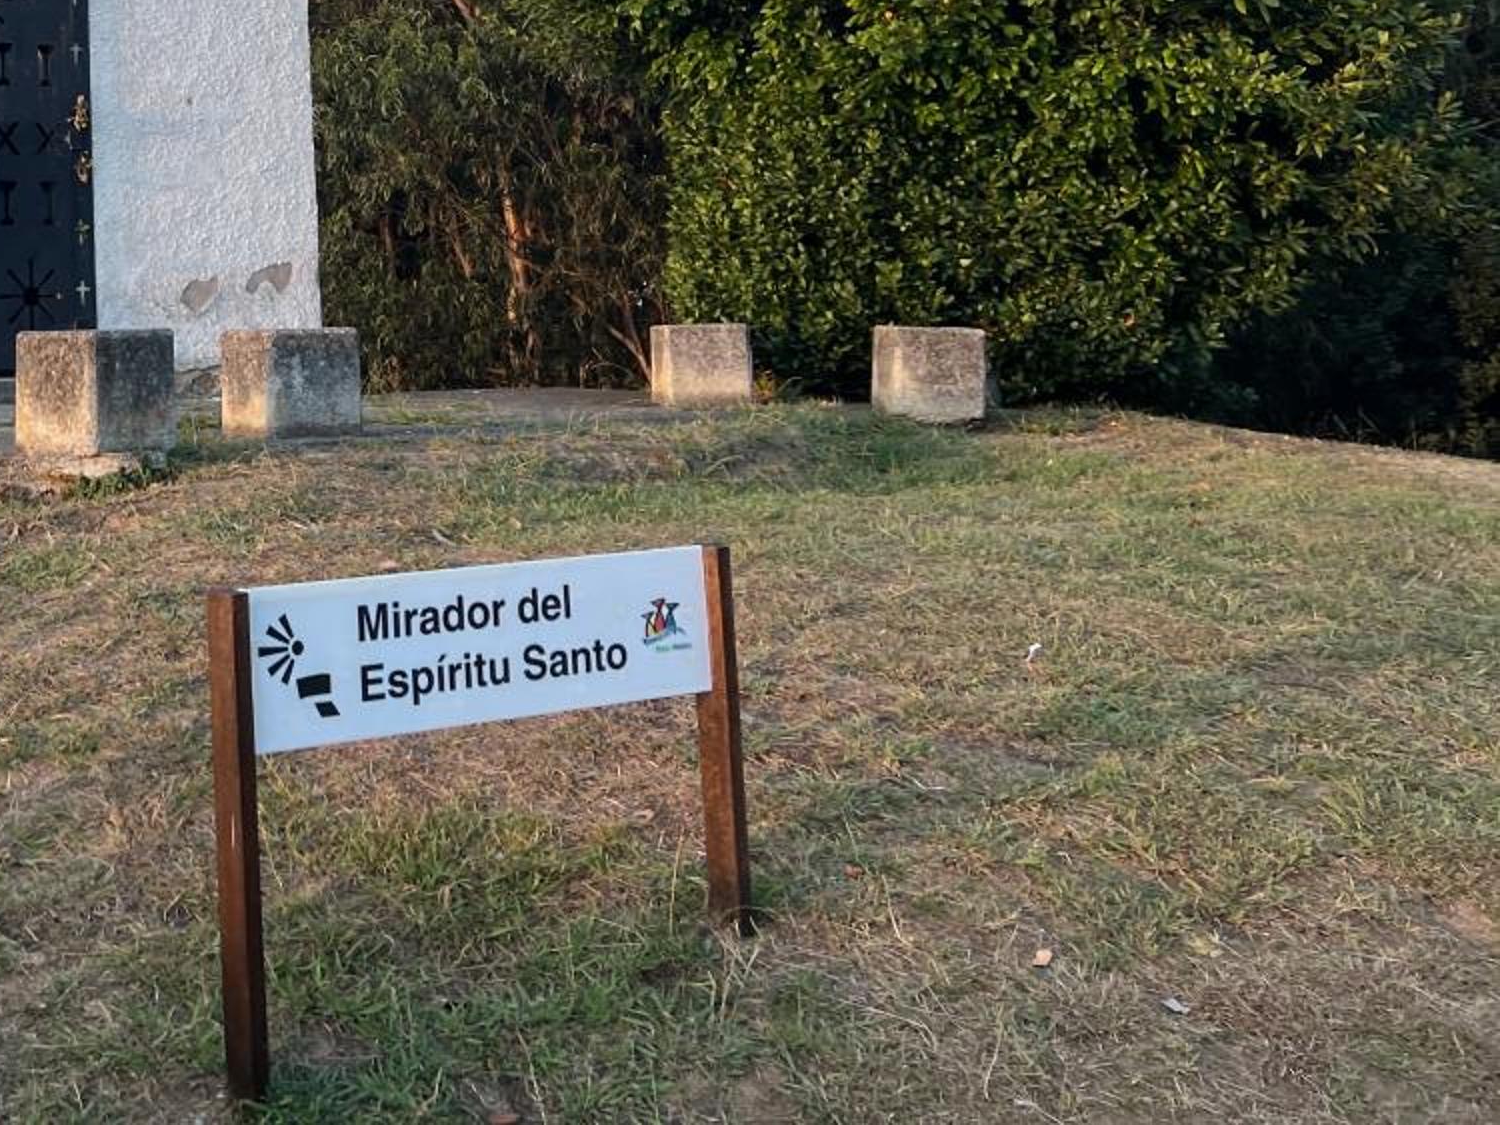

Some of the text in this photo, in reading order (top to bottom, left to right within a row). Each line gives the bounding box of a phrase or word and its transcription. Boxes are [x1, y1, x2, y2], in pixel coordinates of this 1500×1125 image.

[357, 584, 571, 642] Mirador del
[361, 639, 627, 706] Espíritu Santo
